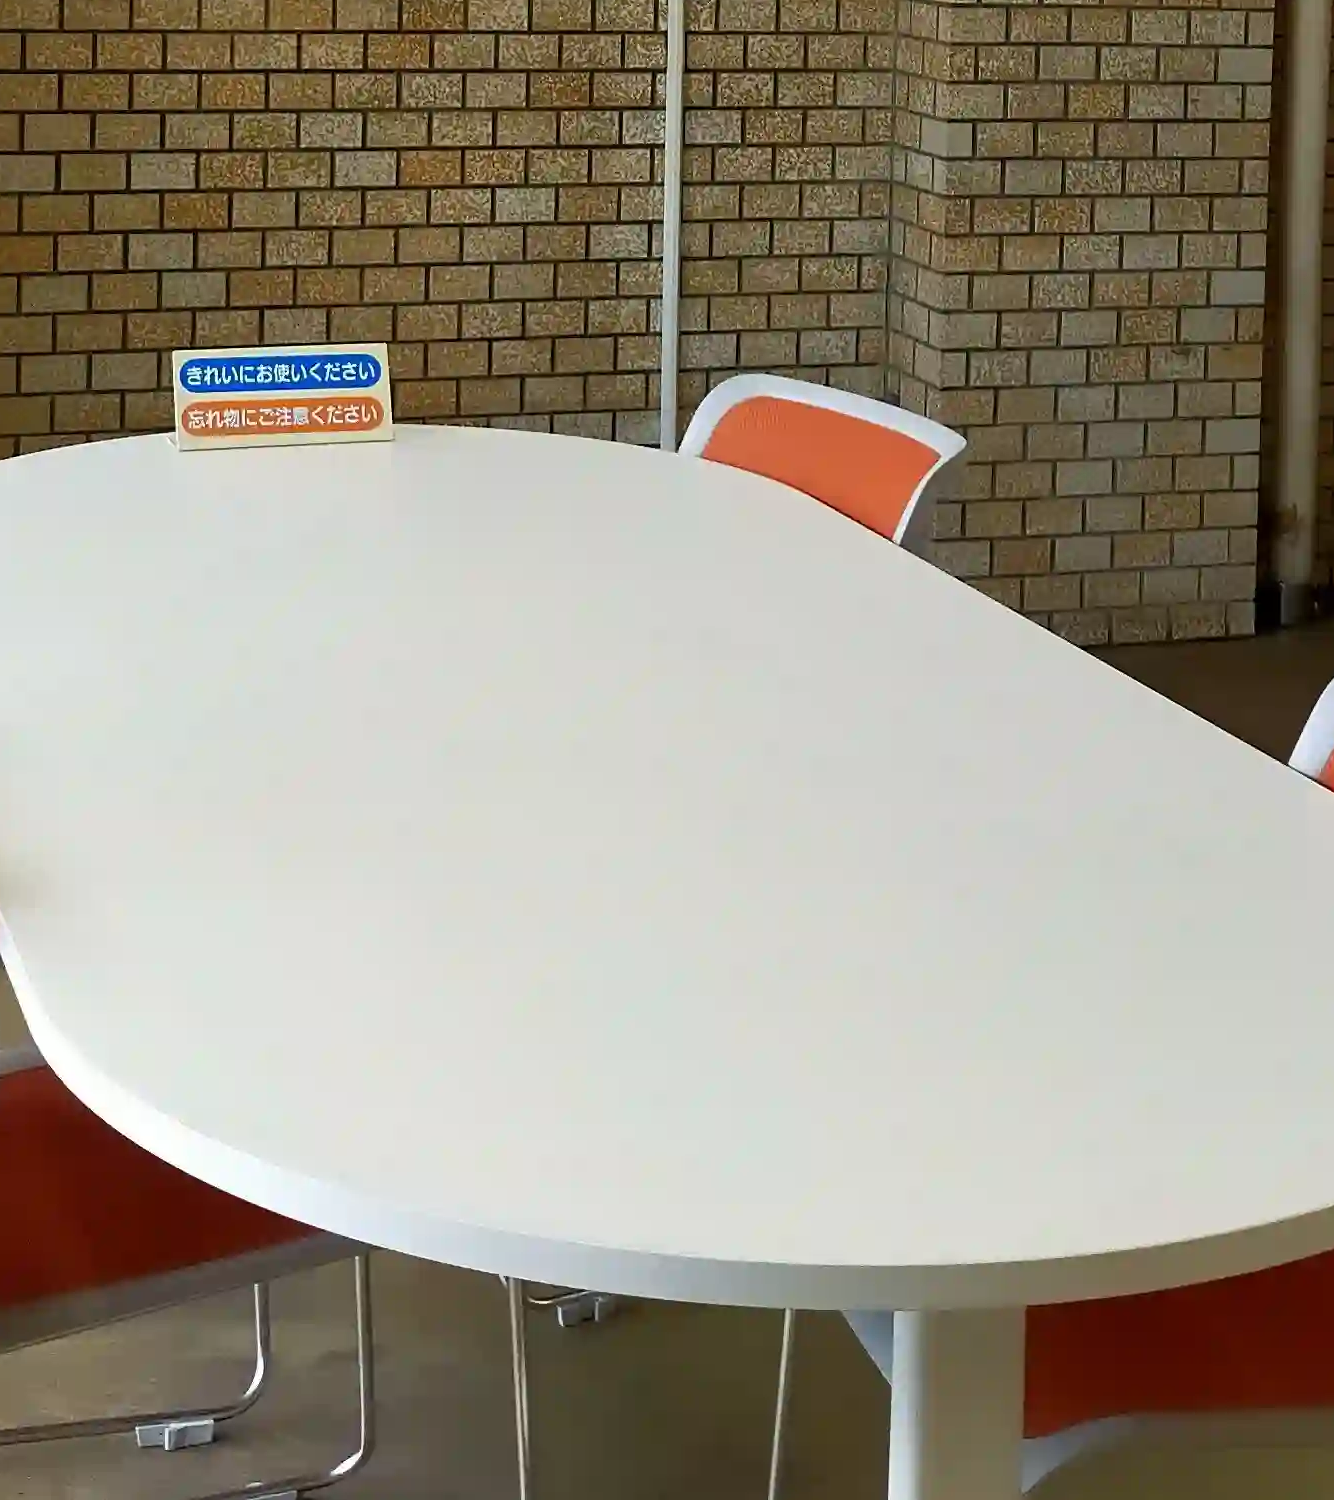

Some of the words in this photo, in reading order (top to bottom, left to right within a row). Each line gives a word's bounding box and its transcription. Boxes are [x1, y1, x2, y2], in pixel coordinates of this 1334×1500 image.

[185, 360, 376, 386] きれいにお使いください
[187, 404, 378, 430] 忘れ物にご注意ください
